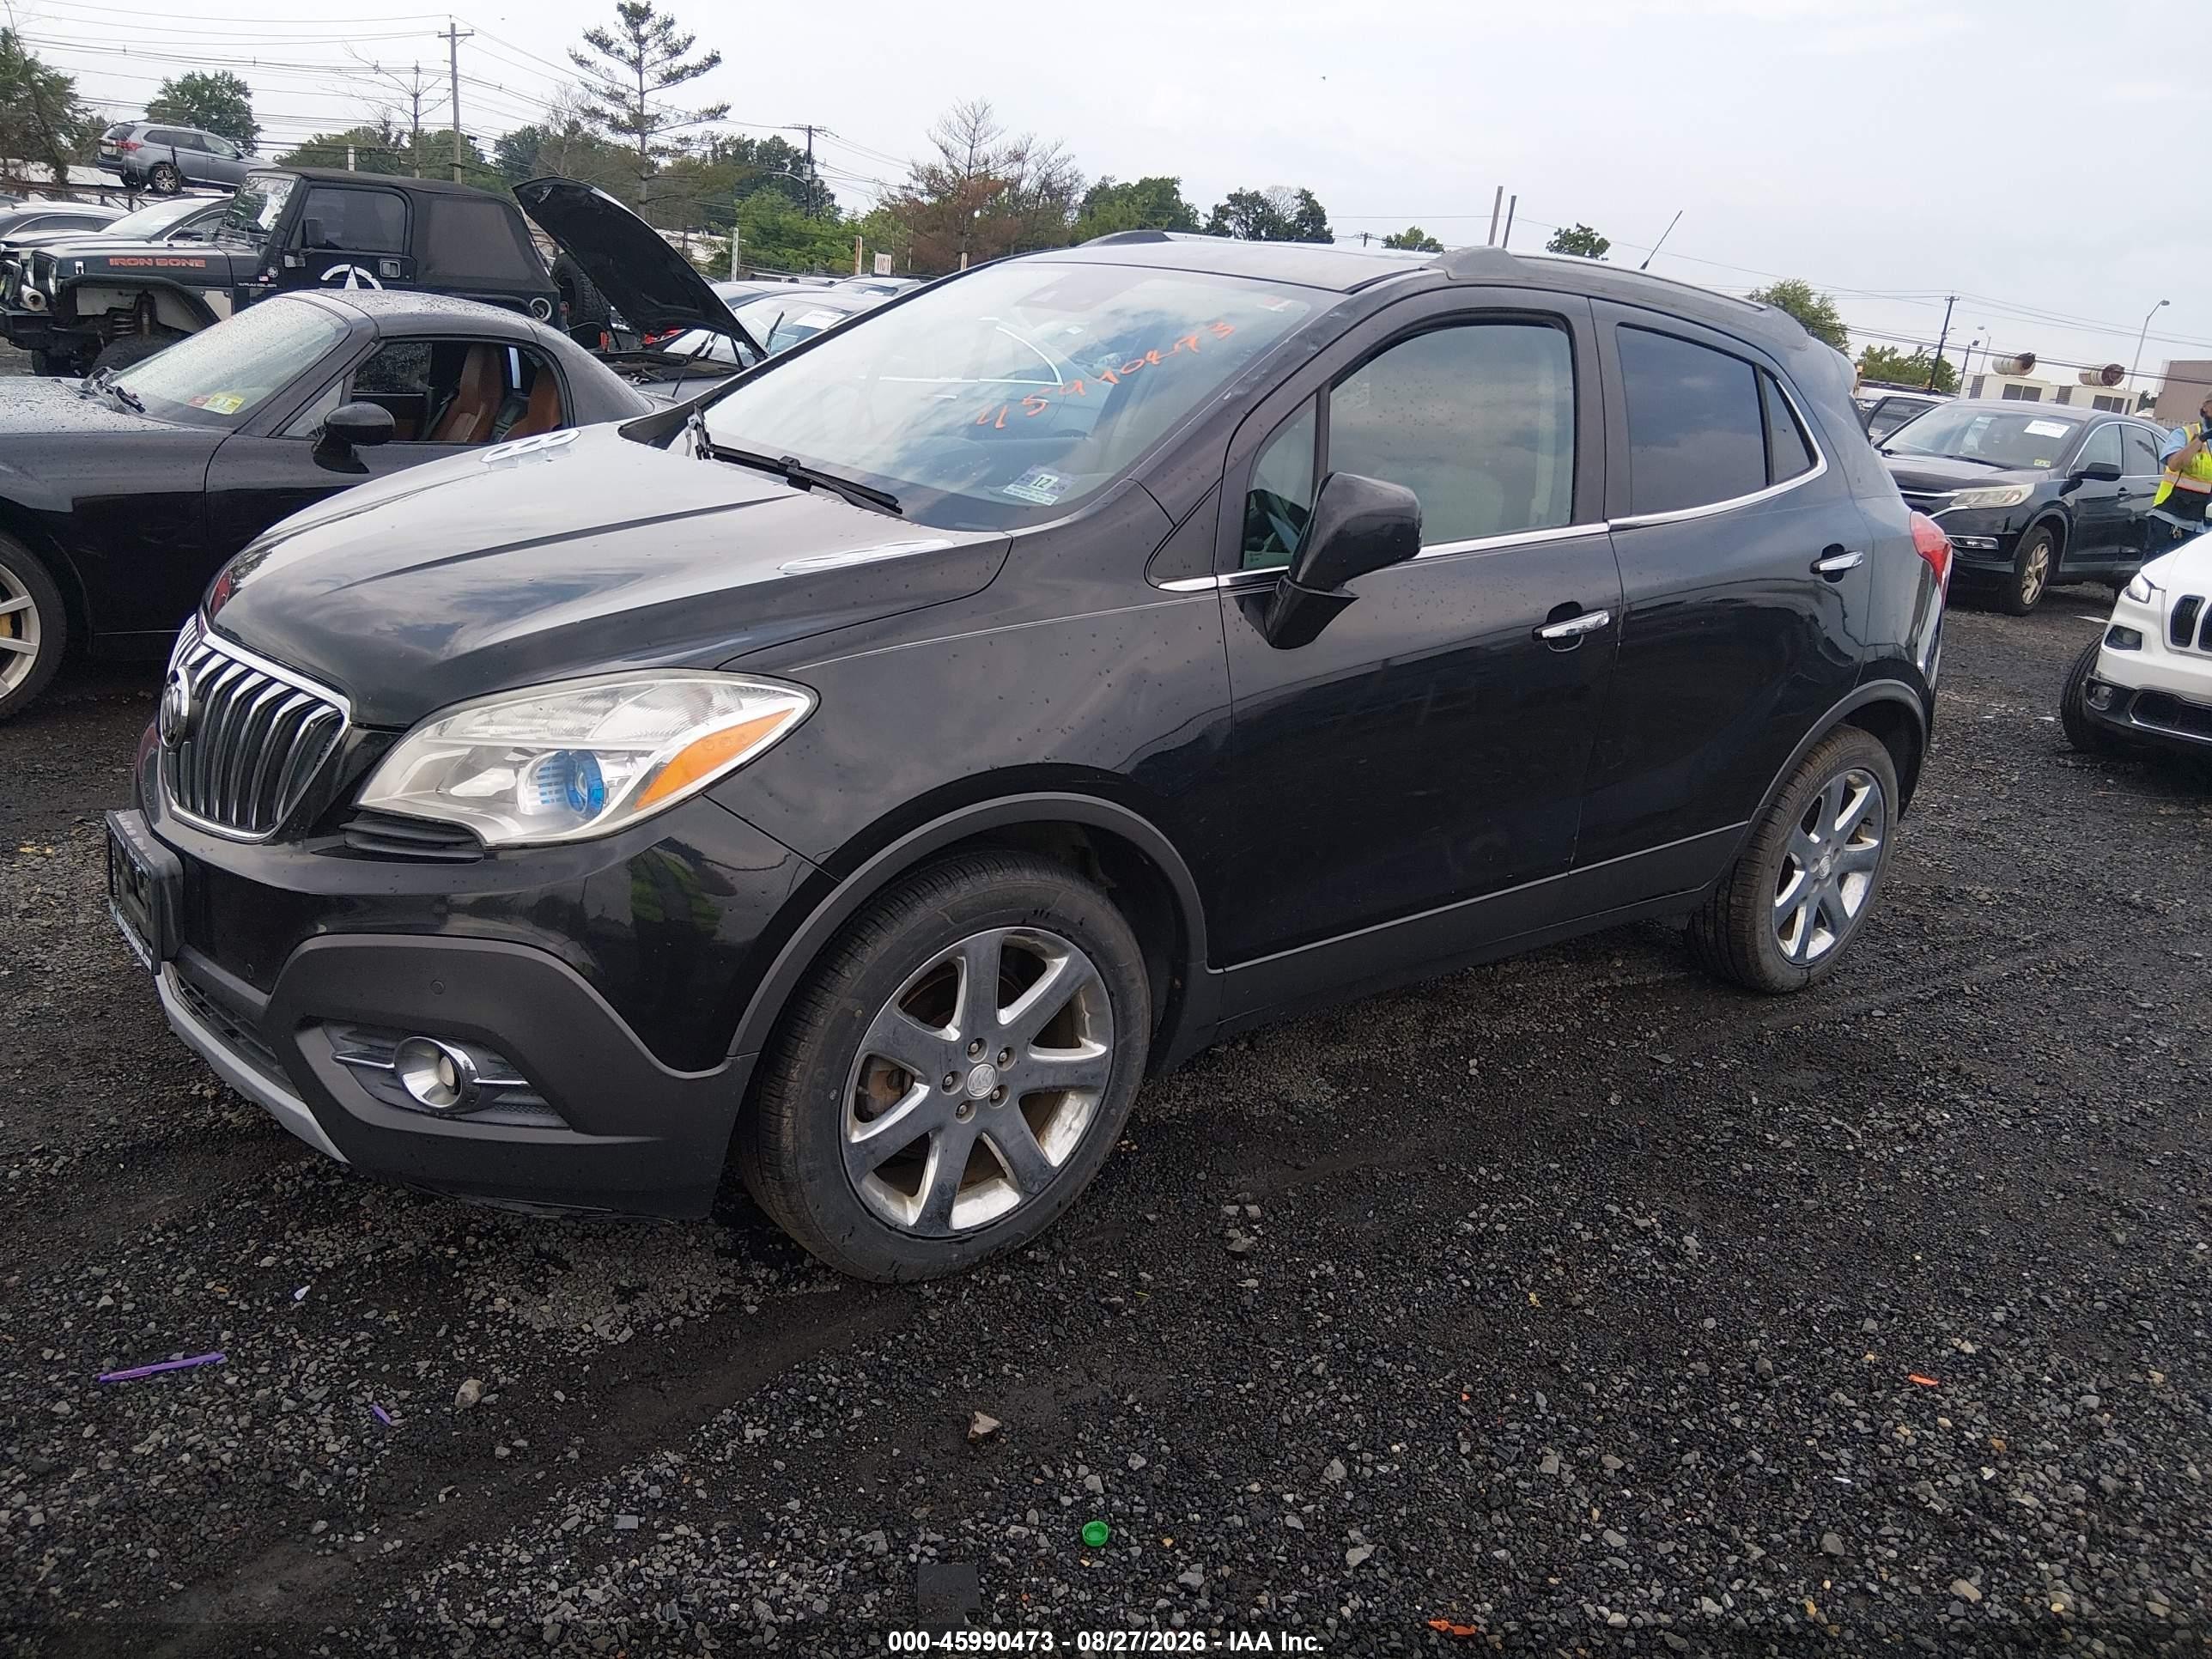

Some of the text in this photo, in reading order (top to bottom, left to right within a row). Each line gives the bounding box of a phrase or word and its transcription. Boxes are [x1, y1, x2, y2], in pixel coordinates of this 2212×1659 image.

[109, 258, 206, 268] IRON BONE
[1032, 476, 1053, 489] 12
